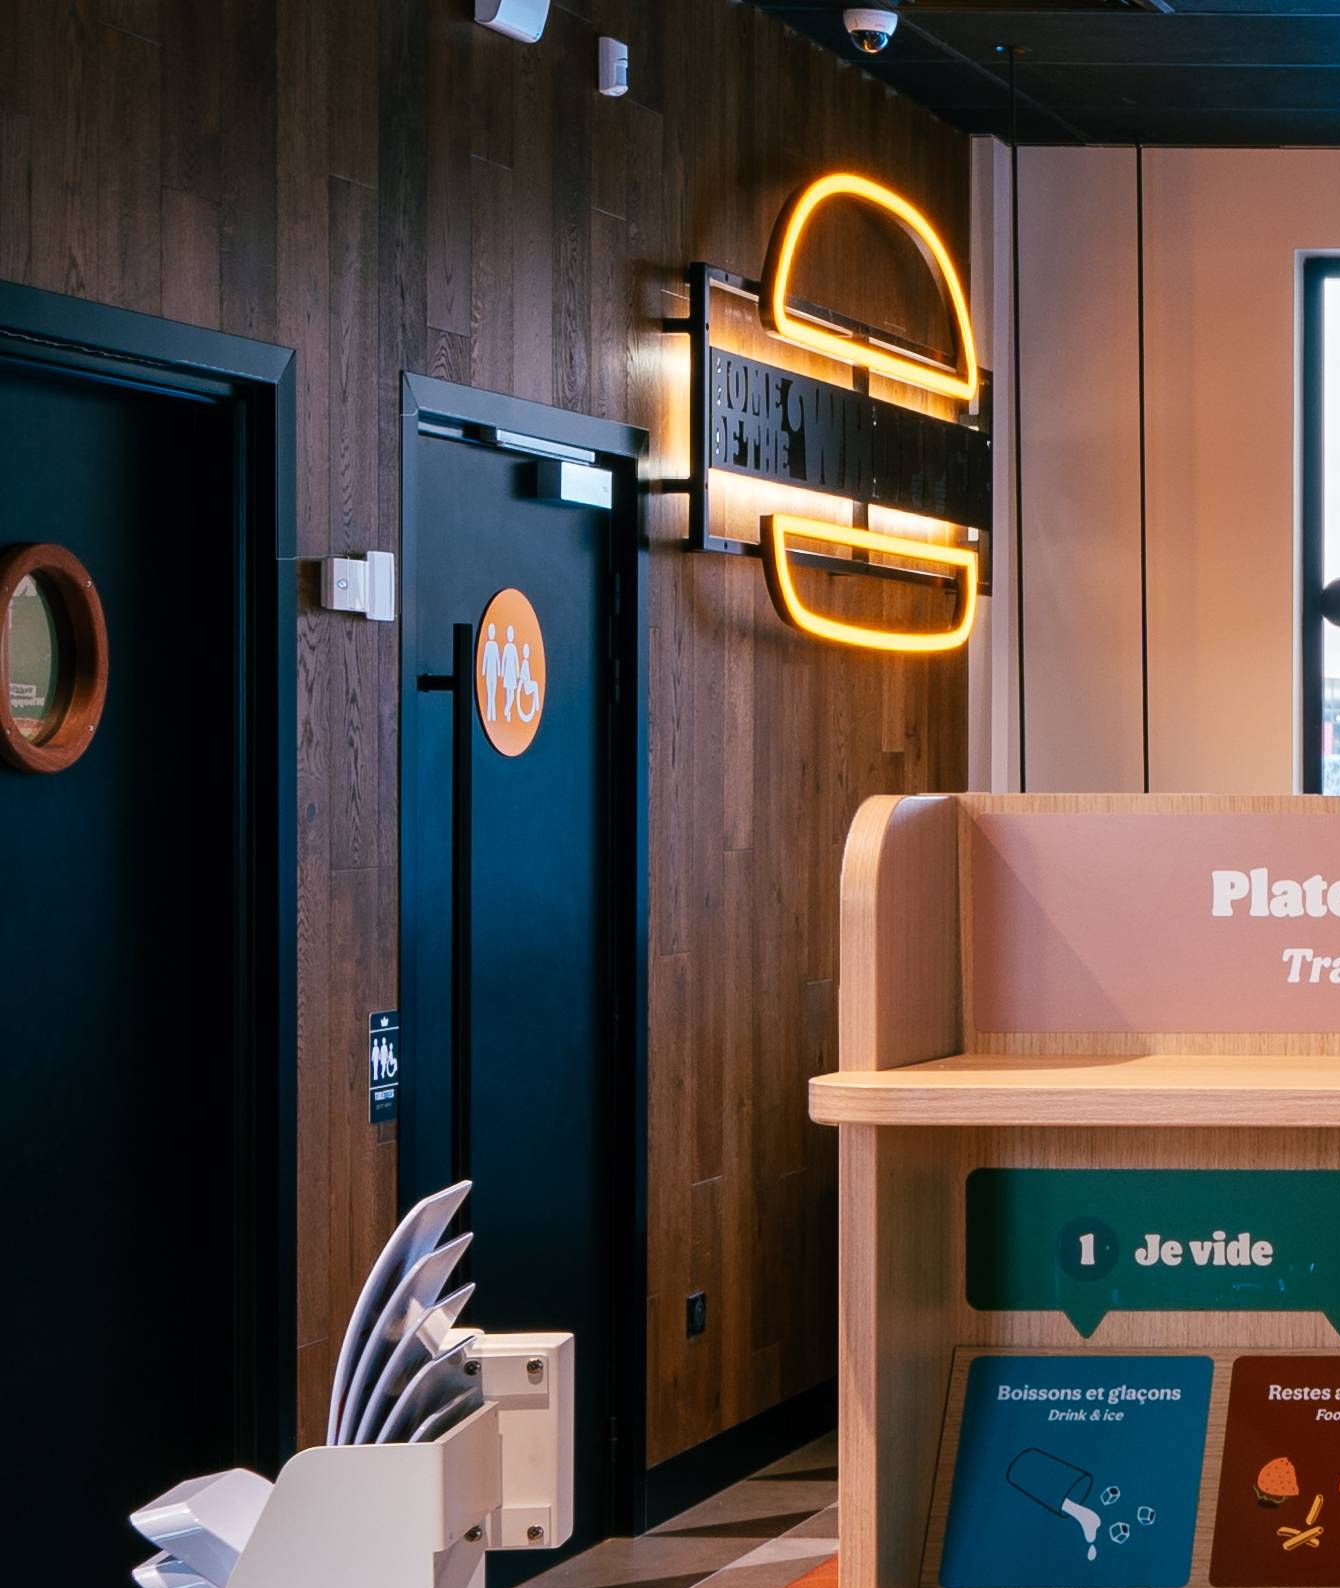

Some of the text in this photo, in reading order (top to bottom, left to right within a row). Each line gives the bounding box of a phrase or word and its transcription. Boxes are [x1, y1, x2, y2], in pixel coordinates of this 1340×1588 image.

[1079, 1230, 1274, 1267] 1 Je vide
[997, 1384, 1182, 1405] Boissons et glaçons
[1268, 1384, 1332, 1401] Restes
[1048, 1408, 1125, 1422] Drink & ice
